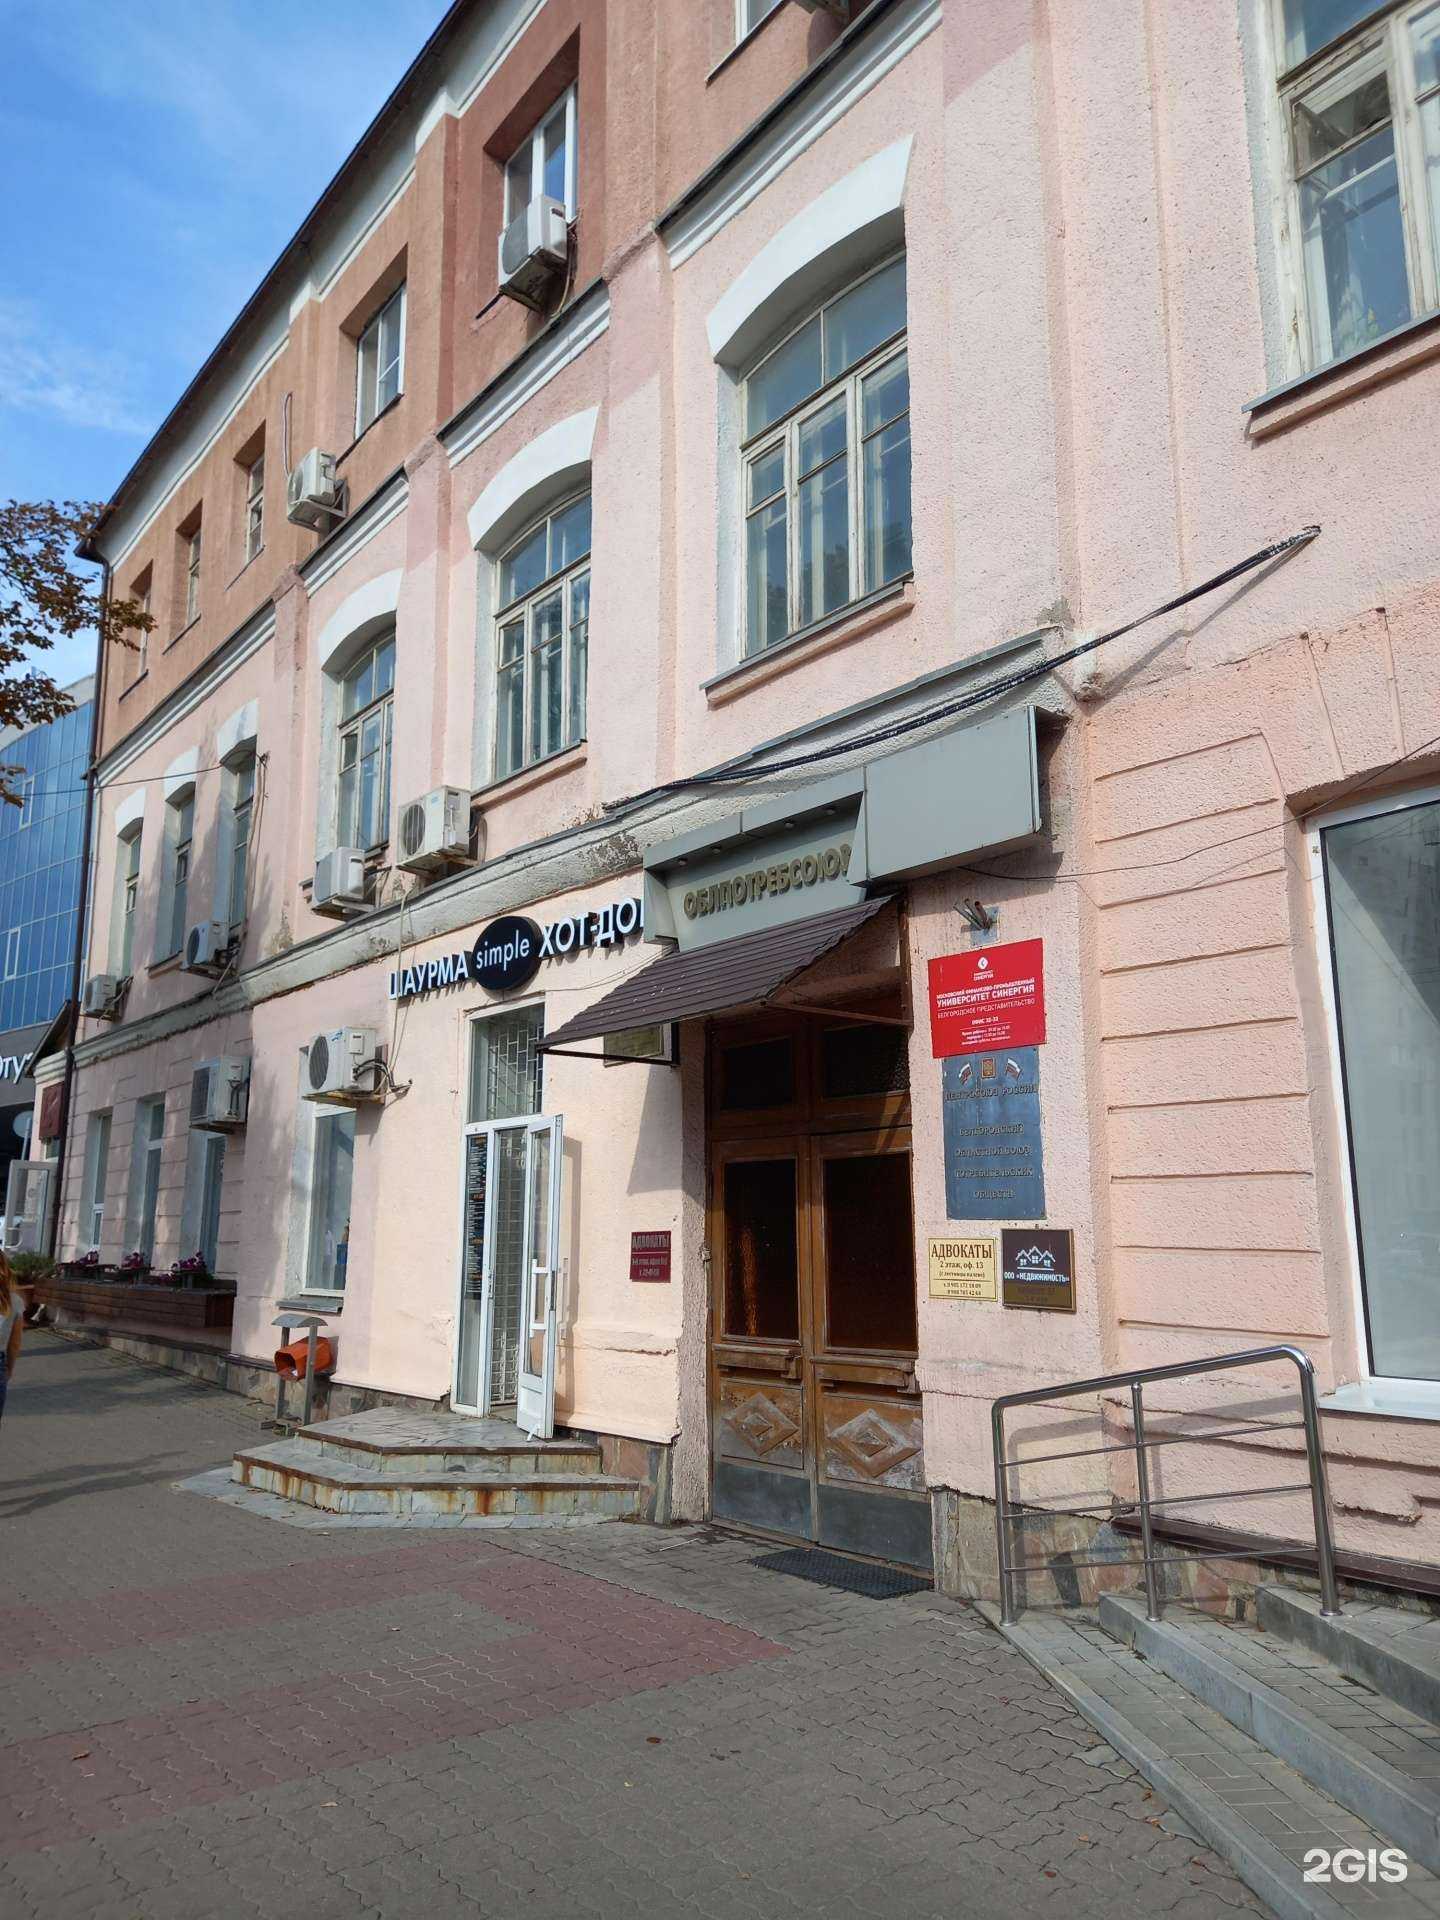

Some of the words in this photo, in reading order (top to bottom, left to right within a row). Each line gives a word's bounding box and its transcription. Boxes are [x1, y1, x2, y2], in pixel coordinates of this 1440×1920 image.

[476, 929, 530, 971] simple
[936, 992, 990, 1008] УНИВЕРСИТЕТ
[992, 984, 1035, 998] СИНЕРГИЯ
[976, 998, 1035, 1012] ПРЕДСТАВИТЕЛЬСТВО
[931, 1244, 992, 1260] АДВОКАТЫ
[963, 1261, 975, 1270] оф.
[1016, 1272, 1069, 1282] «НЕДВИЖИМОСТЬ»
